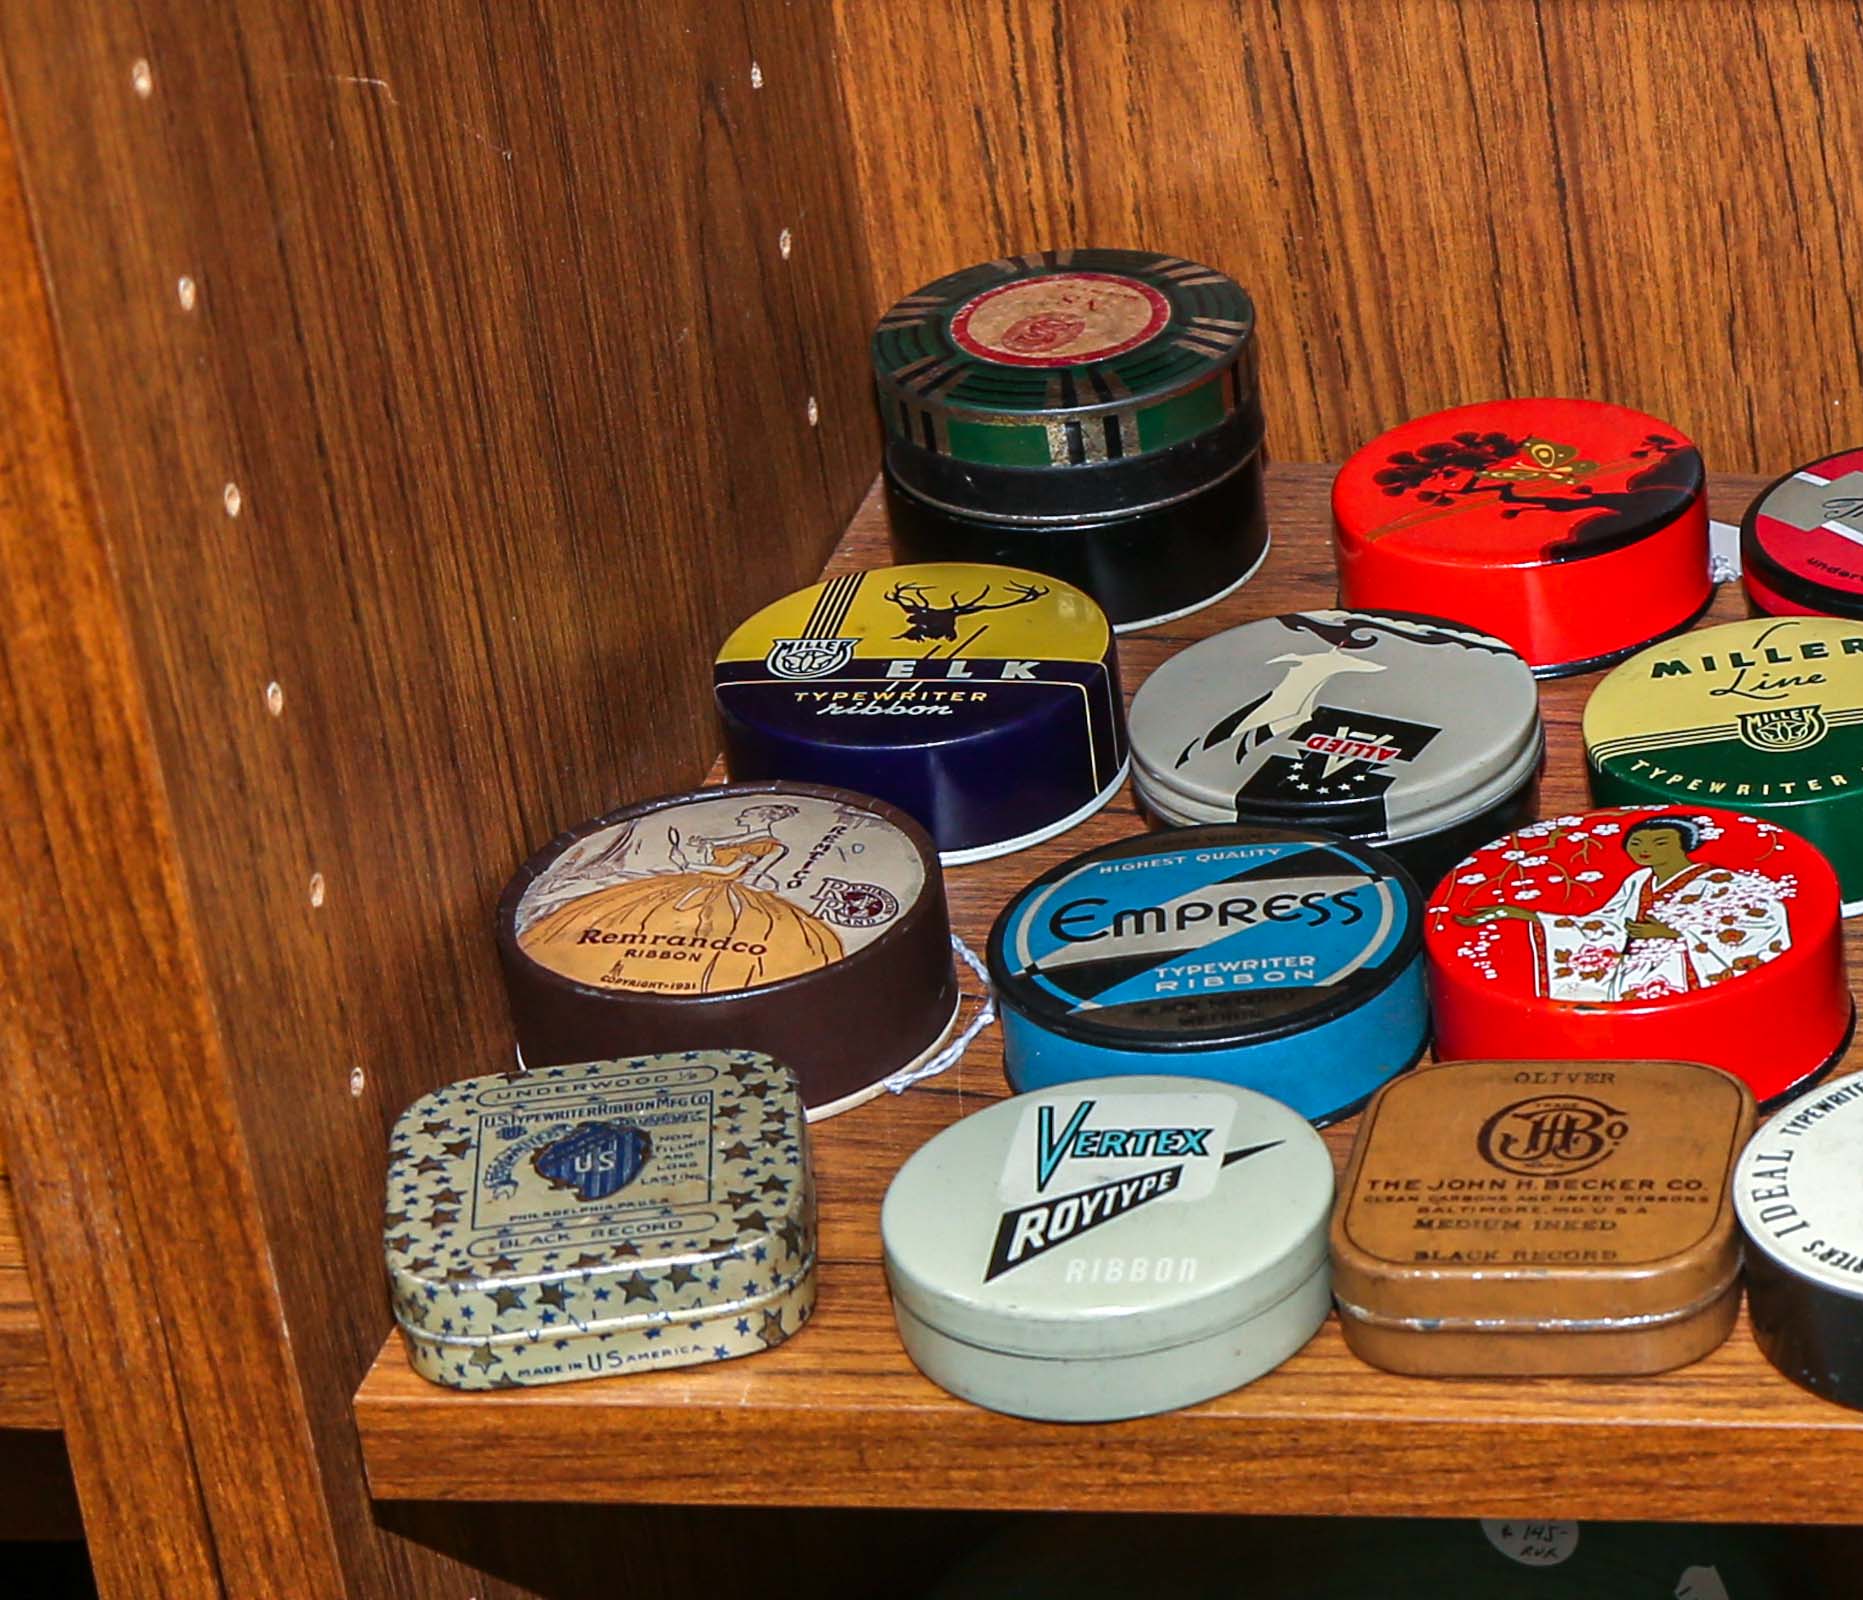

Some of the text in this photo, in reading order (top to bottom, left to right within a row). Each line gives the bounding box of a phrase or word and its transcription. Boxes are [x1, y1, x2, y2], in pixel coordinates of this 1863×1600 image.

[777, 639, 852, 655] MILLER
[1709, 644, 1827, 700] Line
[795, 692, 988, 701] TYPEWRITER
[816, 701, 953, 715] ribbon
[1742, 707, 1819, 727] MILLER
[1305, 737, 1402, 761] ALLIED
[1630, 760, 1847, 795] TYPEWRITER
[1099, 848, 1282, 875] HIGHEST QUALITY
[577, 928, 768, 957] Remrandco
[624, 948, 703, 962] RIBBON
[1154, 955, 1316, 979] TYPEWRITER
[1154, 970, 1316, 992] RIBBON
[497, 1073, 669, 1100] UNDERWOOD
[1514, 1072, 1617, 1085] OLIVER
[597, 1099, 657, 1115] RIBBON
[1036, 1100, 1215, 1194] VERTEX
[1368, 1179, 1708, 1191] THE JOHN BECKER CO.
[1751, 1148, 1811, 1239] IDEAL
[1006, 1170, 1173, 1262] ROYTYPE
[500, 1221, 683, 1249] BLACK RECORD
[1414, 1251, 1618, 1261] BLACK RECORD
[1065, 1258, 1199, 1285] RIBBON
[518, 1344, 704, 1377] MADE IN AMERICA
